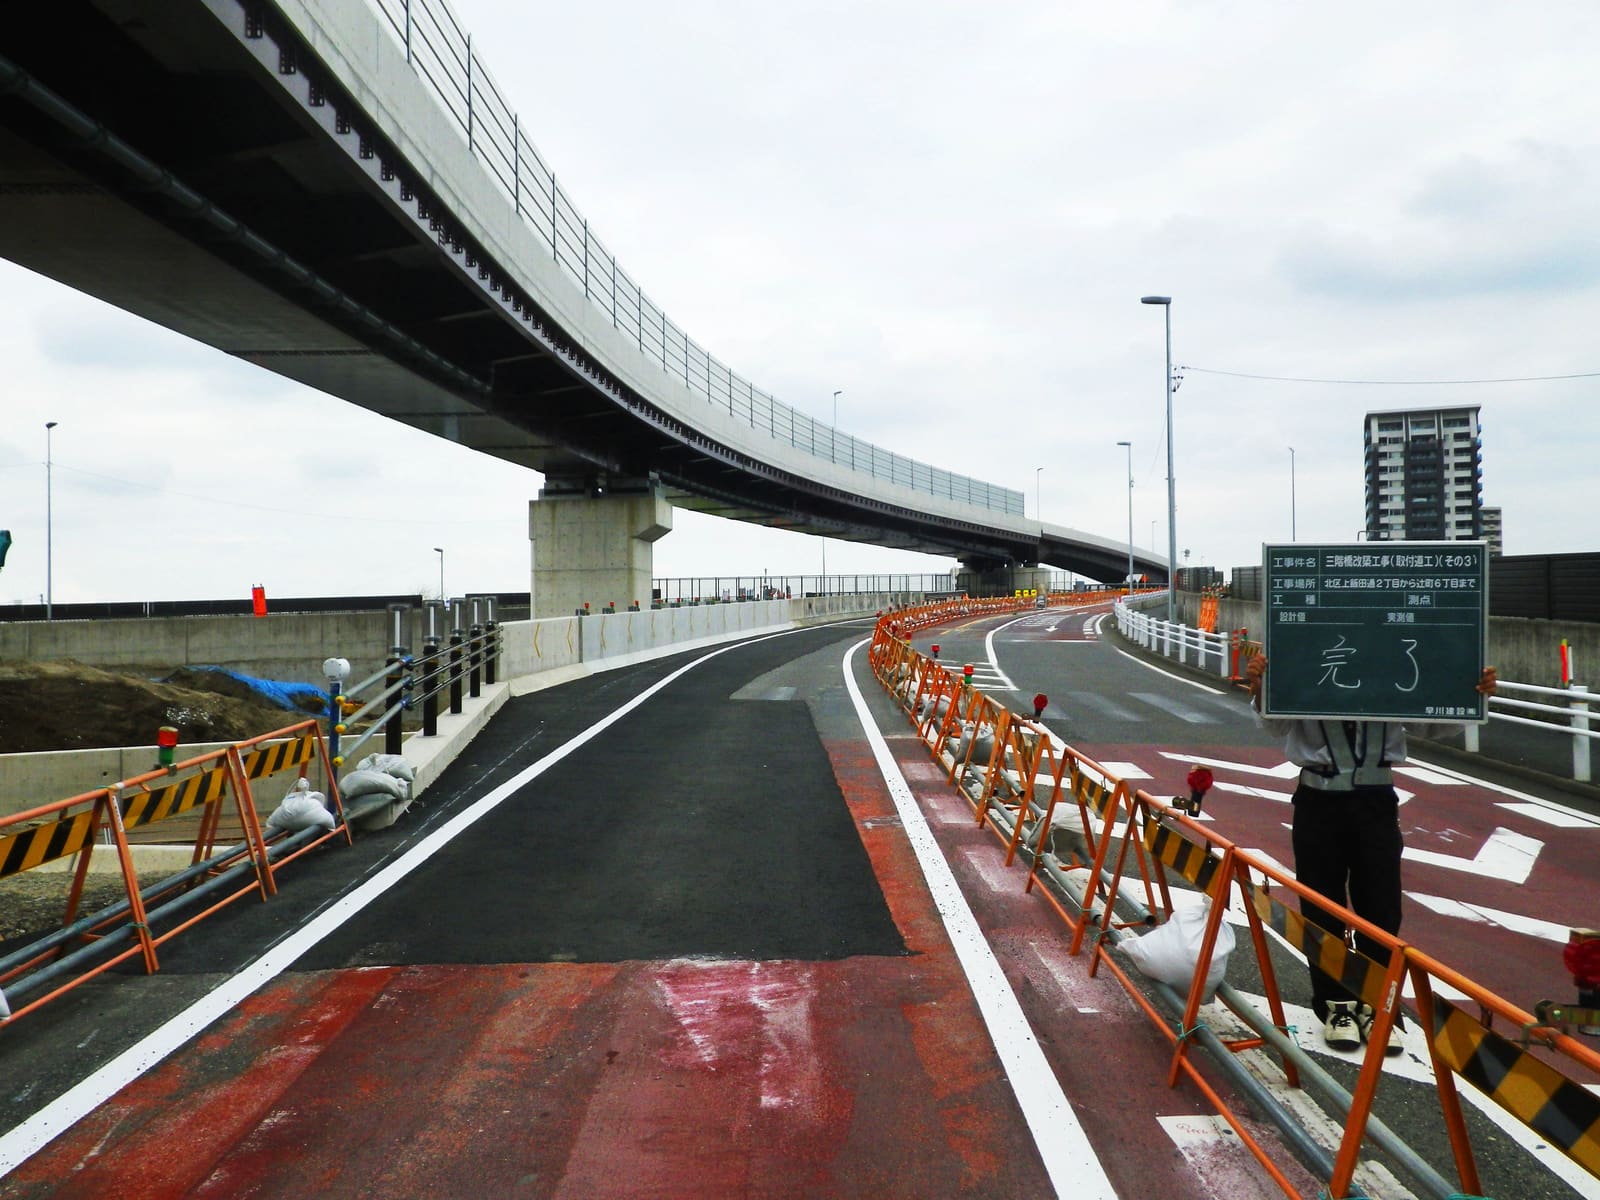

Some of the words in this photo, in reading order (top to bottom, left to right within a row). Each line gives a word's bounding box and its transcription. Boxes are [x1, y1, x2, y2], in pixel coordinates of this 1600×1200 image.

[1273, 557, 1316, 568] 工事件名
[1273, 578, 1316, 589] 工事場所
[1407, 595, 1431, 606] 測点
[1279, 611, 1306, 622] 設計値
[1387, 612, 1415, 623] 実測値
